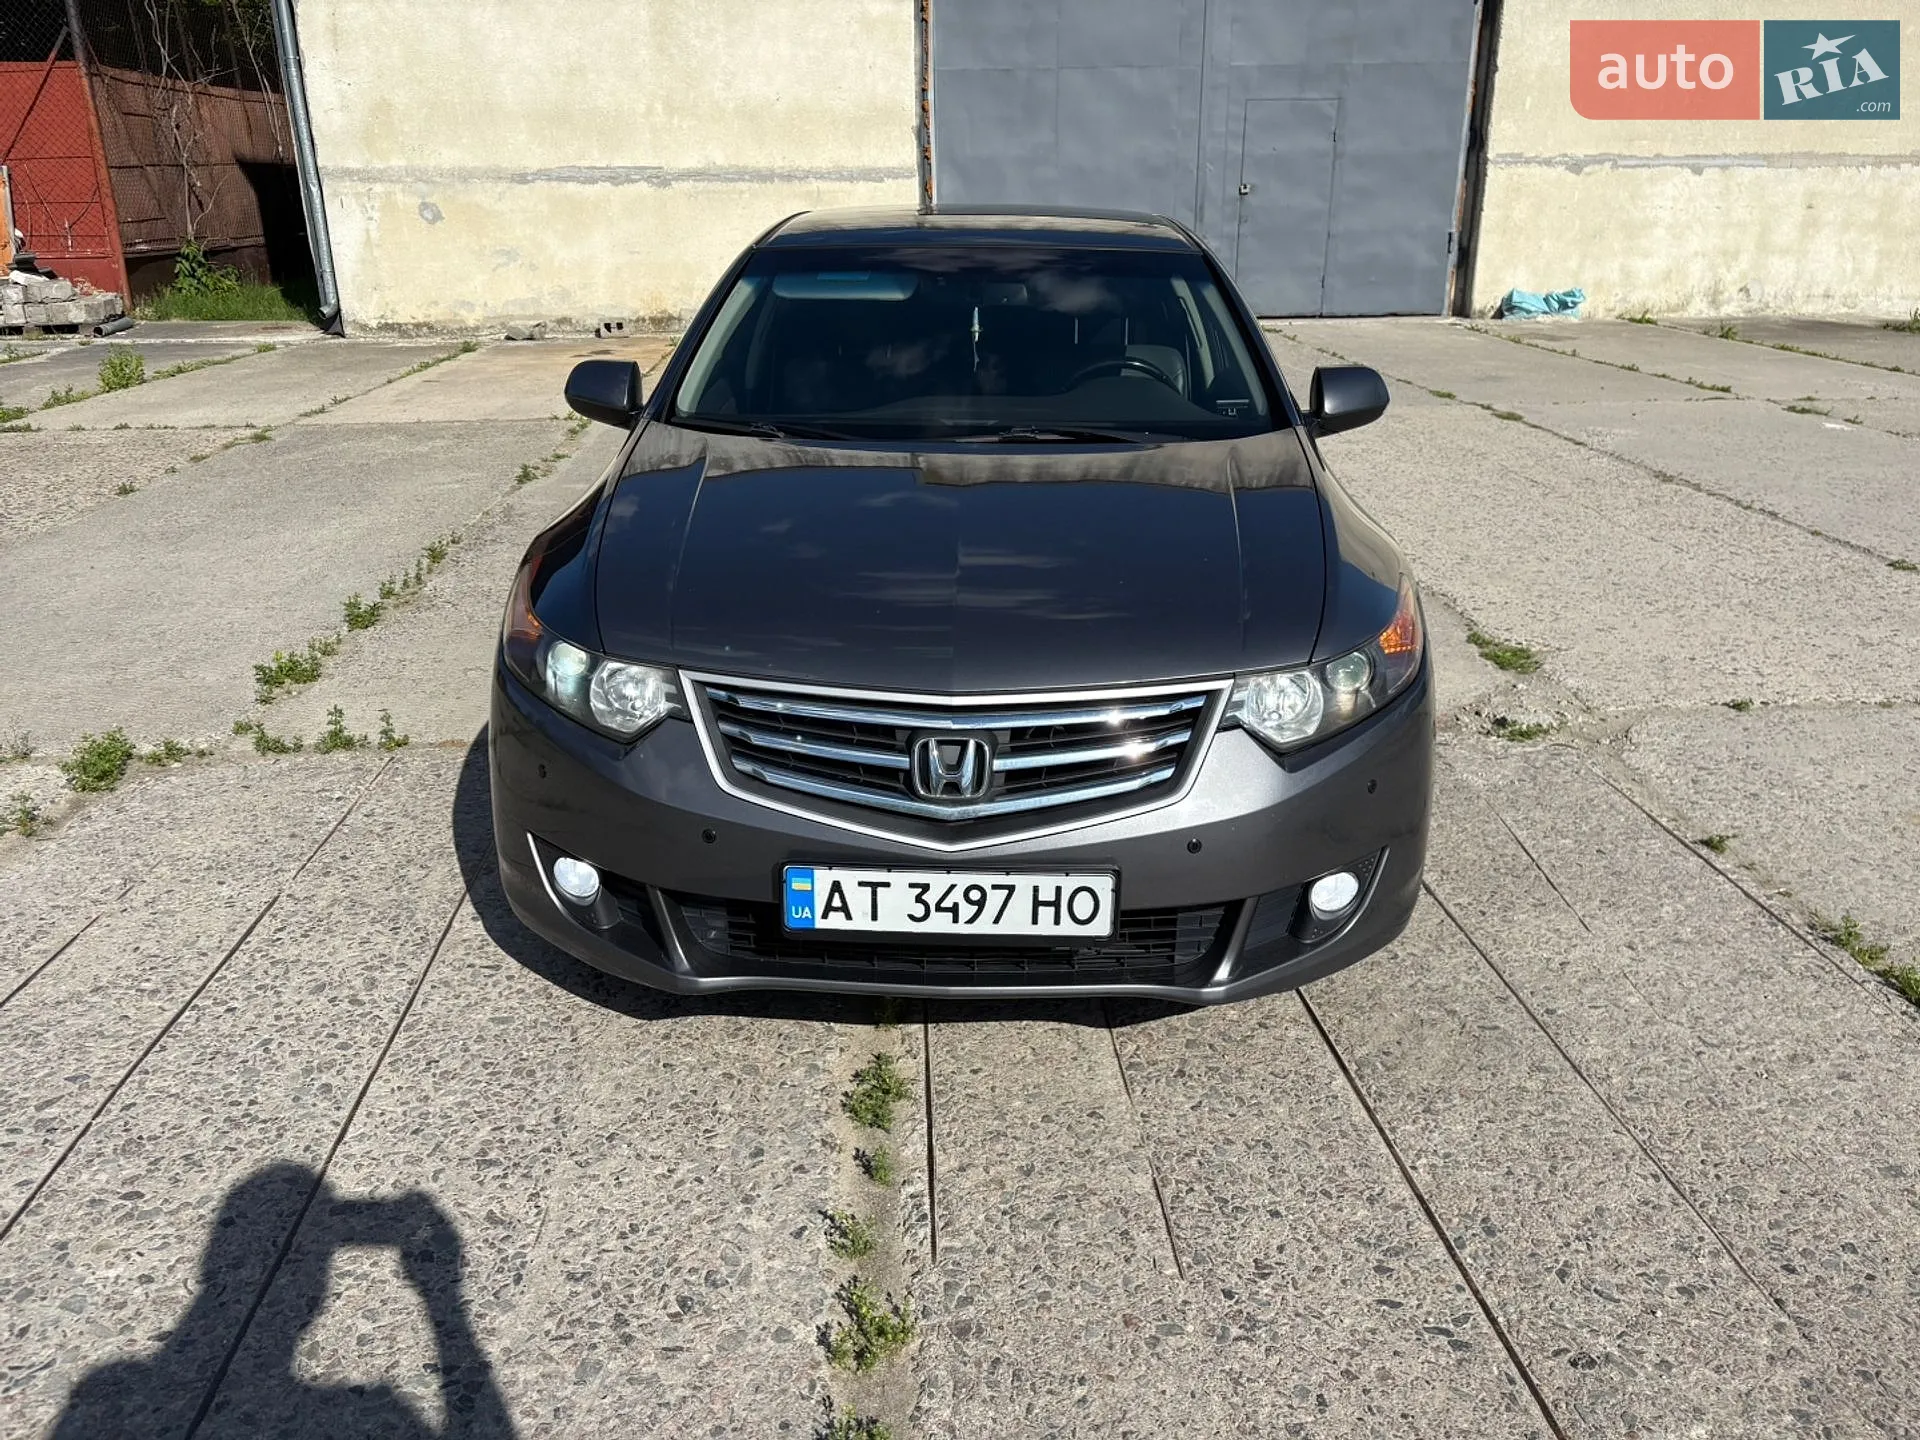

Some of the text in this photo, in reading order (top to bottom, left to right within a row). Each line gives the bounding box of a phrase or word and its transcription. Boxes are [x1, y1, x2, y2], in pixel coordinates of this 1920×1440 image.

[791, 906, 813, 919] UA
[820, 880, 1100, 926] AT 3497 HO
